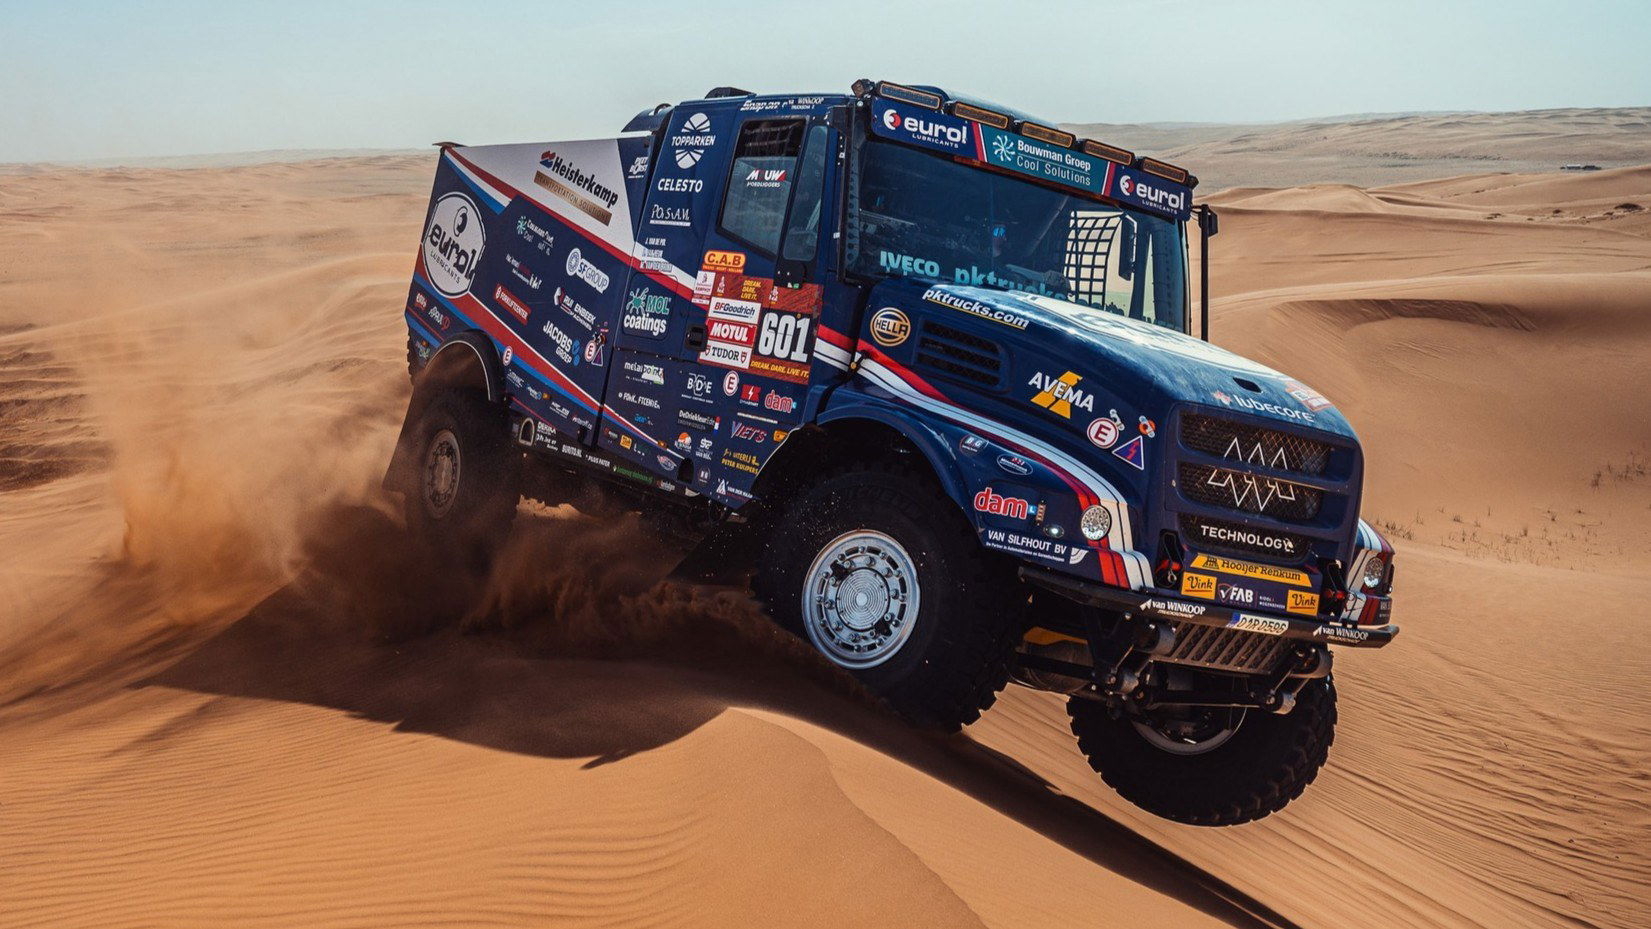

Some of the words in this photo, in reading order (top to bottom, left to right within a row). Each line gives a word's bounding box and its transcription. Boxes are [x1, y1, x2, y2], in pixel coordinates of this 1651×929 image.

[671, 135, 716, 147] TOPPARKEN
[904, 116, 967, 144] eurol
[912, 133, 959, 149] LUBRICANTS
[1017, 140, 1063, 163] Bouwman
[1065, 154, 1091, 172] Groep
[1016, 155, 1039, 171] Cool
[1044, 163, 1091, 186] Solutions
[551, 156, 618, 208] Heisterkamp
[657, 178, 703, 193] CELESTO
[1136, 182, 1185, 210] eurol
[1141, 200, 1178, 214] LUBRICANTS
[429, 223, 477, 280] eurol
[880, 250, 940, 277] IVECO
[645, 294, 671, 316] MOL
[715, 301, 755, 316] BFGoodrich
[921, 287, 1030, 329] pktrucks.com
[623, 313, 667, 337] coatings
[710, 322, 748, 343] MOTUL
[875, 318, 908, 337] HELLA
[542, 320, 573, 353] JACOBS
[758, 312, 811, 363] 601
[711, 347, 740, 361] TUDOR
[750, 361, 770, 370] DREAM.
[770, 364, 786, 374] DARE.
[787, 368, 800, 377] LIVE
[764, 389, 793, 414] dam
[1027, 371, 1095, 413] AVEMA
[1232, 394, 1316, 423] lubecore
[1093, 423, 1112, 444] E
[974, 486, 1028, 520] dam
[988, 529, 1005, 542] VAN
[1008, 534, 1051, 552] SILFHOUT
[1054, 544, 1067, 555] BV
[1187, 576, 1213, 590] Vink
[1260, 567, 1301, 581] Renkum
[1229, 587, 1254, 603] FAB
[1292, 593, 1316, 606] Vink
[1153, 600, 1166, 609] van
[1166, 601, 1206, 615] WINKOOP
[1322, 627, 1335, 636] van
[1335, 627, 1369, 640] WINKOOP
